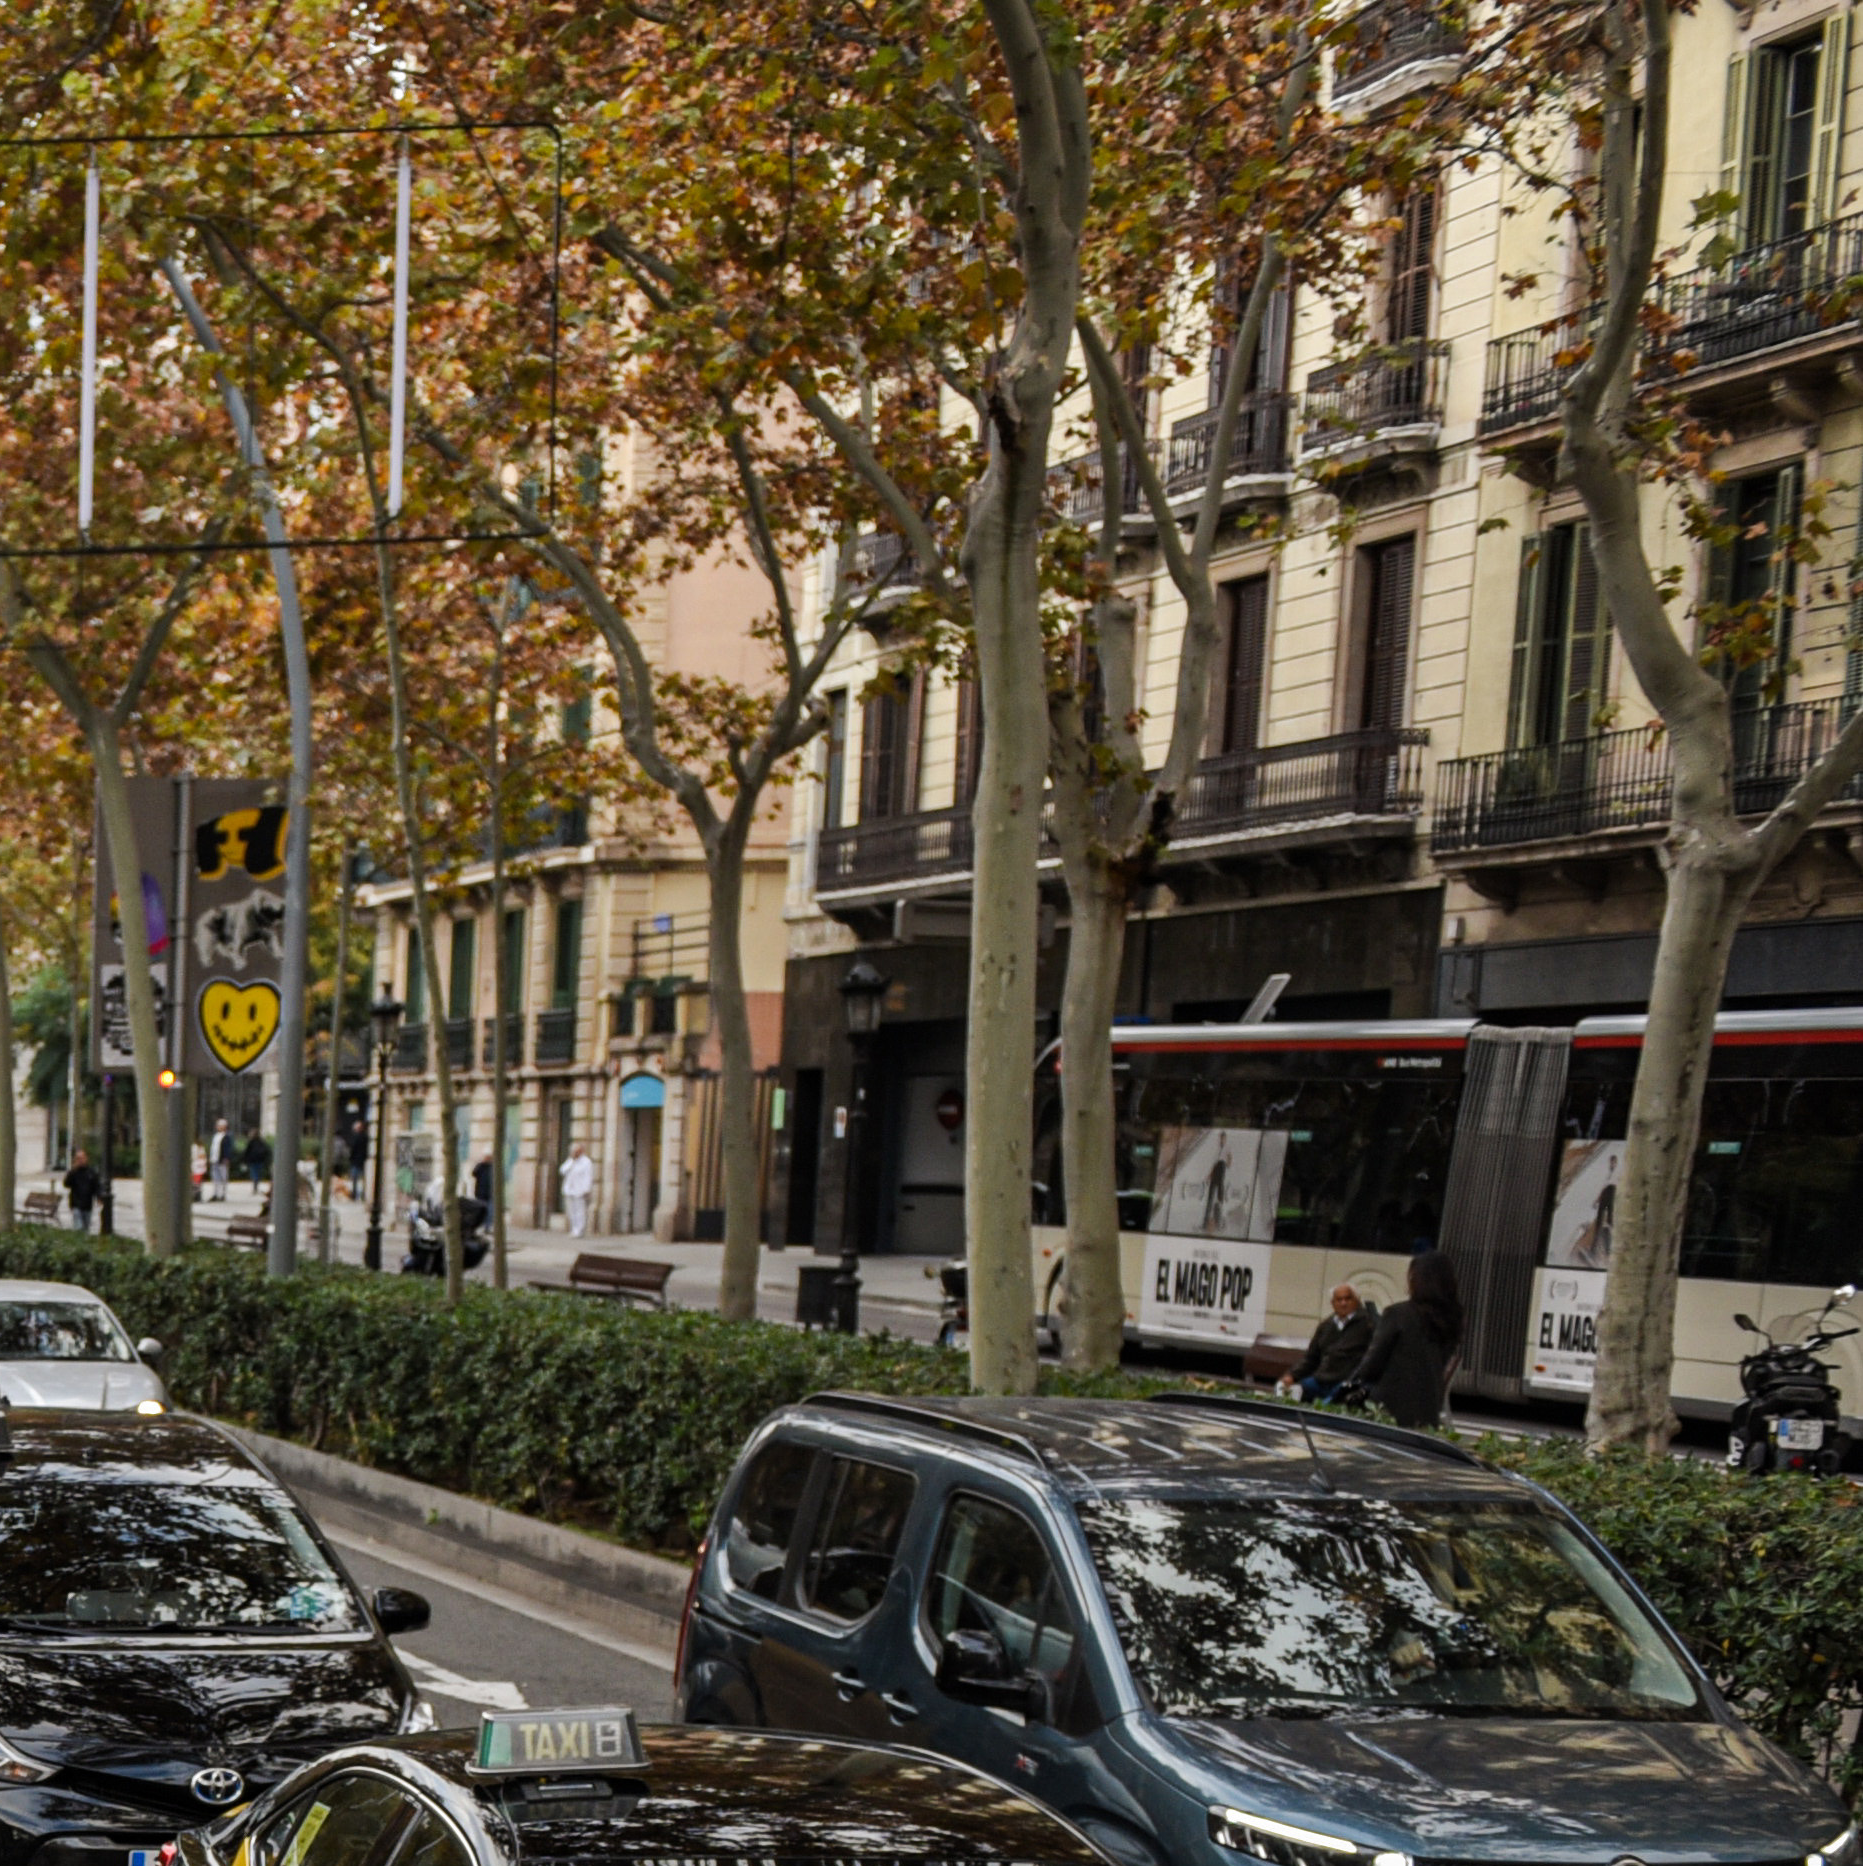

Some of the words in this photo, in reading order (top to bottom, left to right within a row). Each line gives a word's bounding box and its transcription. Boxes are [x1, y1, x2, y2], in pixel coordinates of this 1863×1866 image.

[1156, 1258, 1170, 1303] EL
[1174, 1260, 1219, 1309] MAGO
[1219, 1264, 1253, 1312] POP
[1539, 1312, 1554, 1349] EL
[519, 1721, 591, 1761] TAXI
